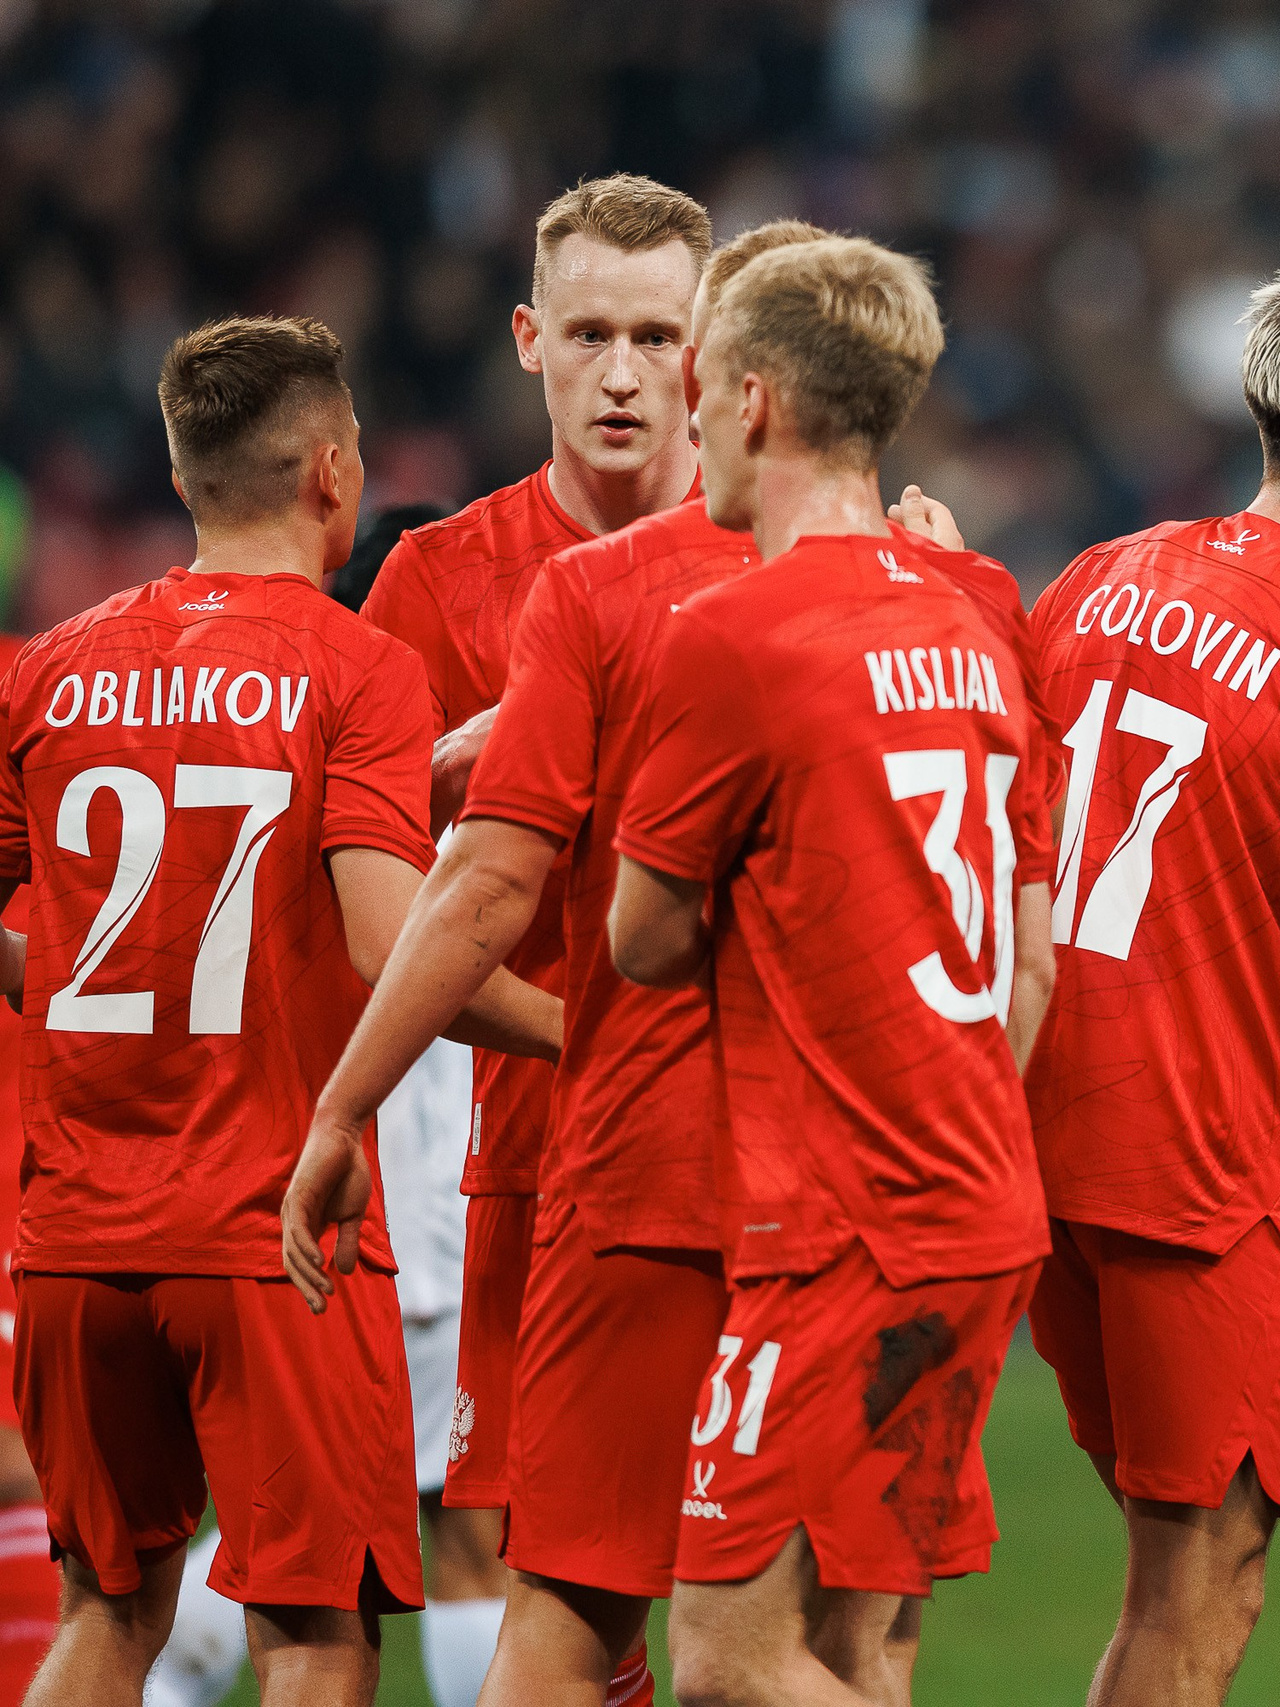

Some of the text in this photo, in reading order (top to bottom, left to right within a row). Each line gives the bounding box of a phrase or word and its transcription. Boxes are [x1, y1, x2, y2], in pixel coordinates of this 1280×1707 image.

[45, 666, 310, 733] OBLIAKOV
[1051, 680, 1209, 961] 17
[46, 764, 293, 1035] 27
[882, 749, 1020, 1028] 31
[690, 1334, 782, 1456] 31
